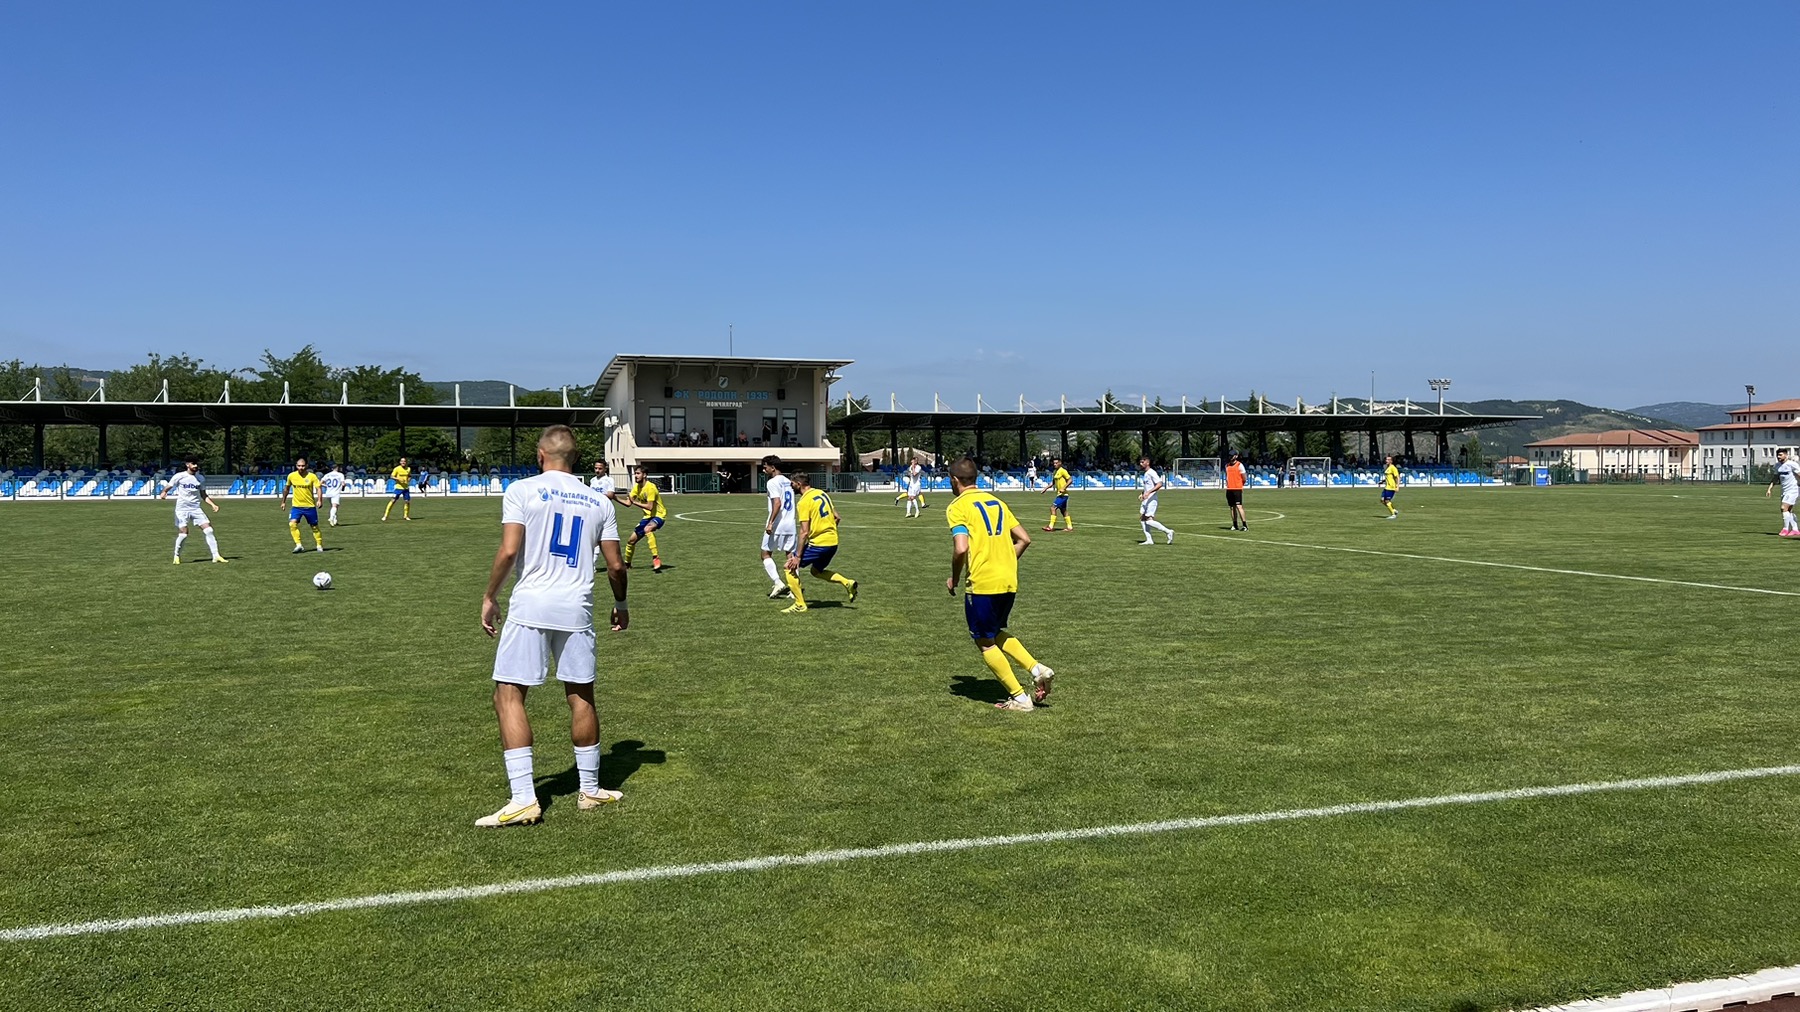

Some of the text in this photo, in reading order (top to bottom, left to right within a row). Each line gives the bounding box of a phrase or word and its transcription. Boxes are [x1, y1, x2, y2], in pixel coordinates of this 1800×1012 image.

[674, 390, 689, 400] ФК
[325, 478, 339, 488] 20
[783, 490, 793, 511] 8
[812, 492, 834, 518] 21
[973, 500, 1004, 536] 17
[549, 512, 584, 568] 4
